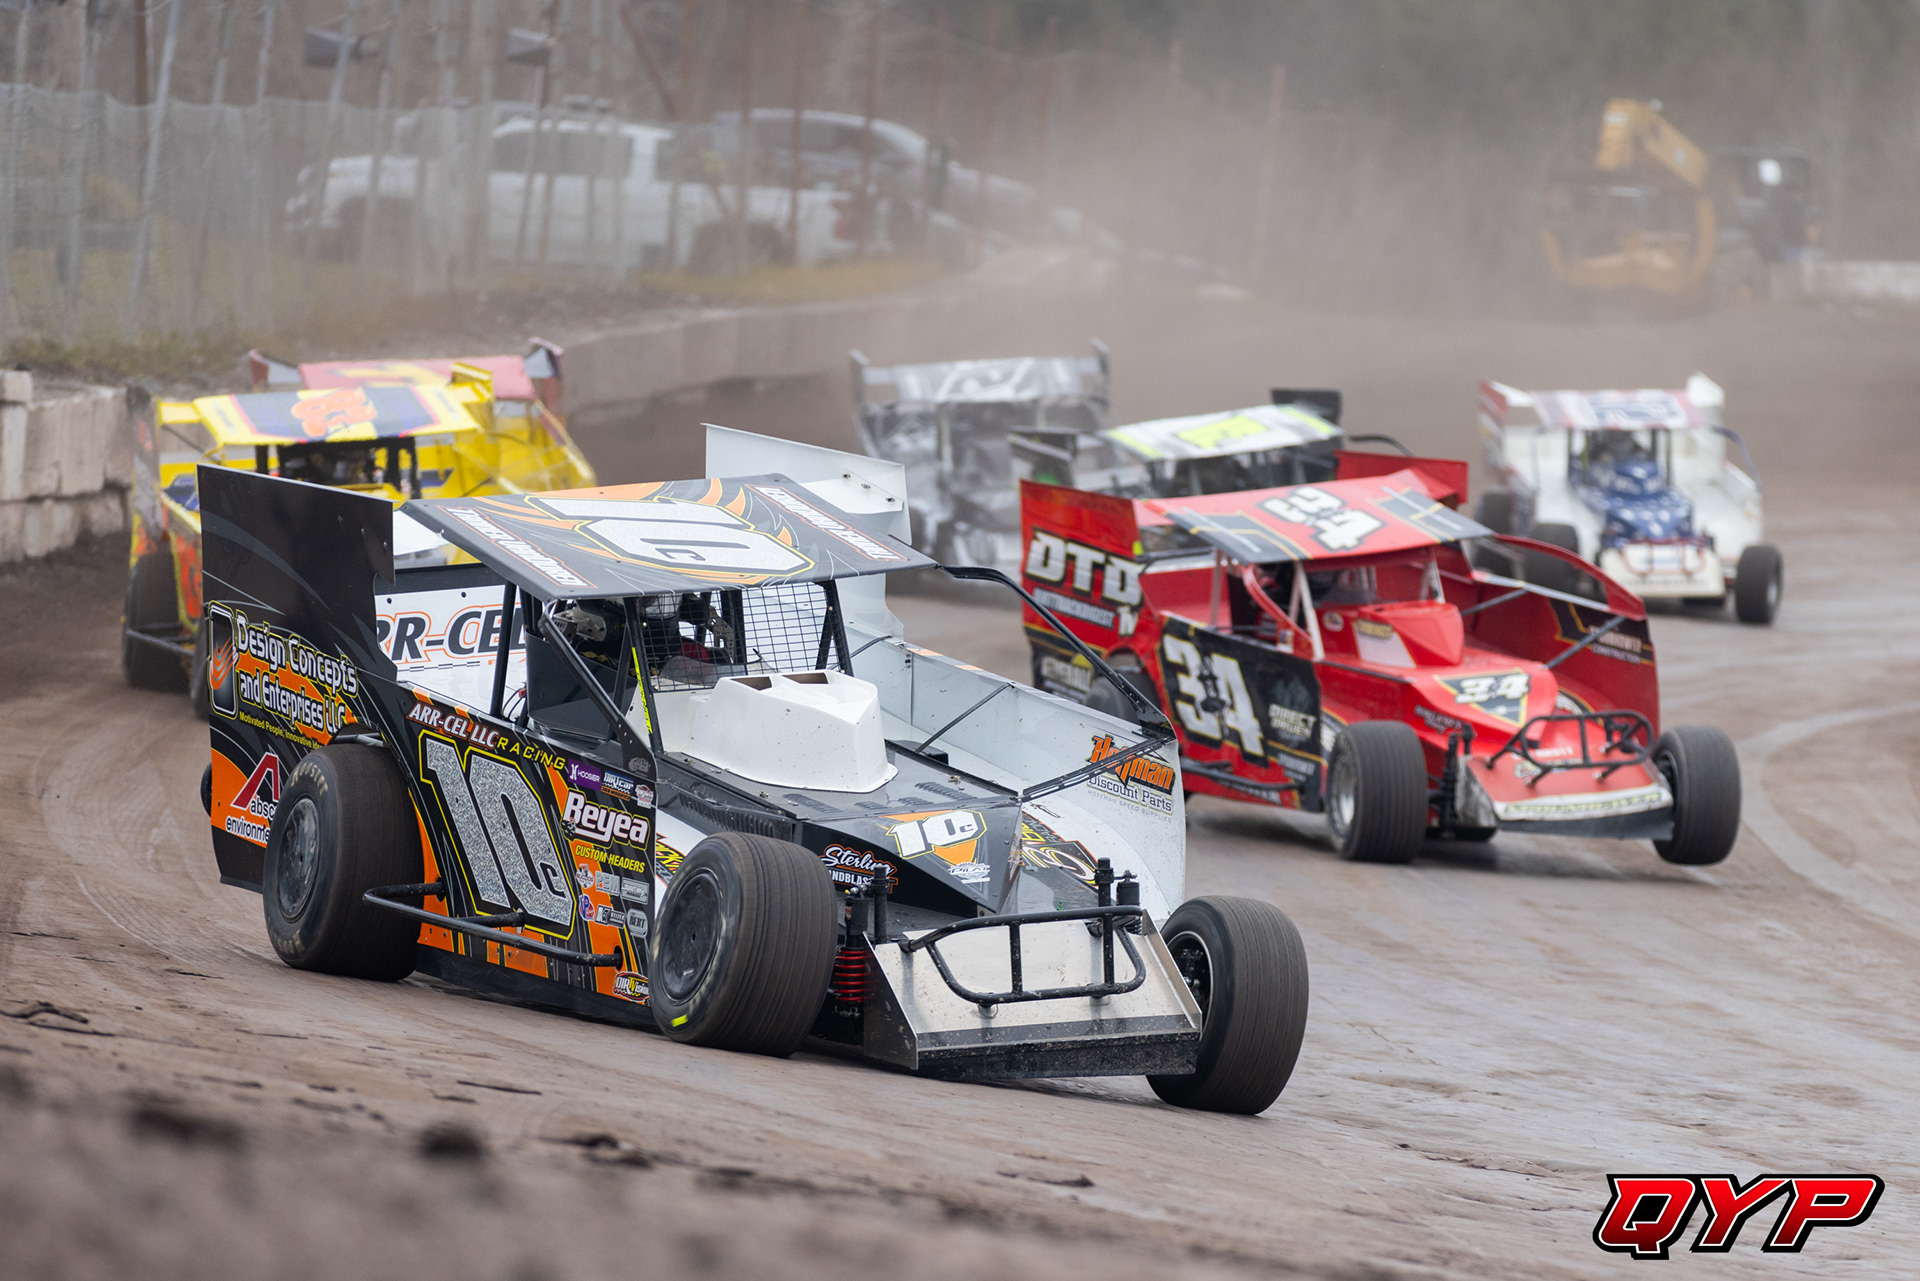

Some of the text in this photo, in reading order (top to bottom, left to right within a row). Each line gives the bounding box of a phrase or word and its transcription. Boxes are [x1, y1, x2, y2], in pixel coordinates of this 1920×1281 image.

[1025, 531, 1143, 606] DTD
[237, 614, 357, 694] Design Concepts
[376, 608, 526, 661] RR-CEL
[240, 672, 261, 703] and
[262, 674, 324, 725] Enterprises
[1163, 634, 1265, 757] 34
[1455, 673, 1530, 703] 34
[240, 711, 265, 729] Motivated
[265, 721, 285, 738] People,
[285, 729, 312, 748] Innovative
[409, 703, 566, 769] ARR-CEL LLC RACING
[577, 770, 600, 783] HOOSIER
[1088, 775, 1172, 811] Discount Parts
[563, 790, 648, 844] Beyea
[1088, 790, 1172, 824] HOFFMAN SPEED SUPPLIES
[575, 844, 608, 863] CUSTOM
[608, 853, 646, 873] HEADERS
[595, 870, 620, 894] PEM
